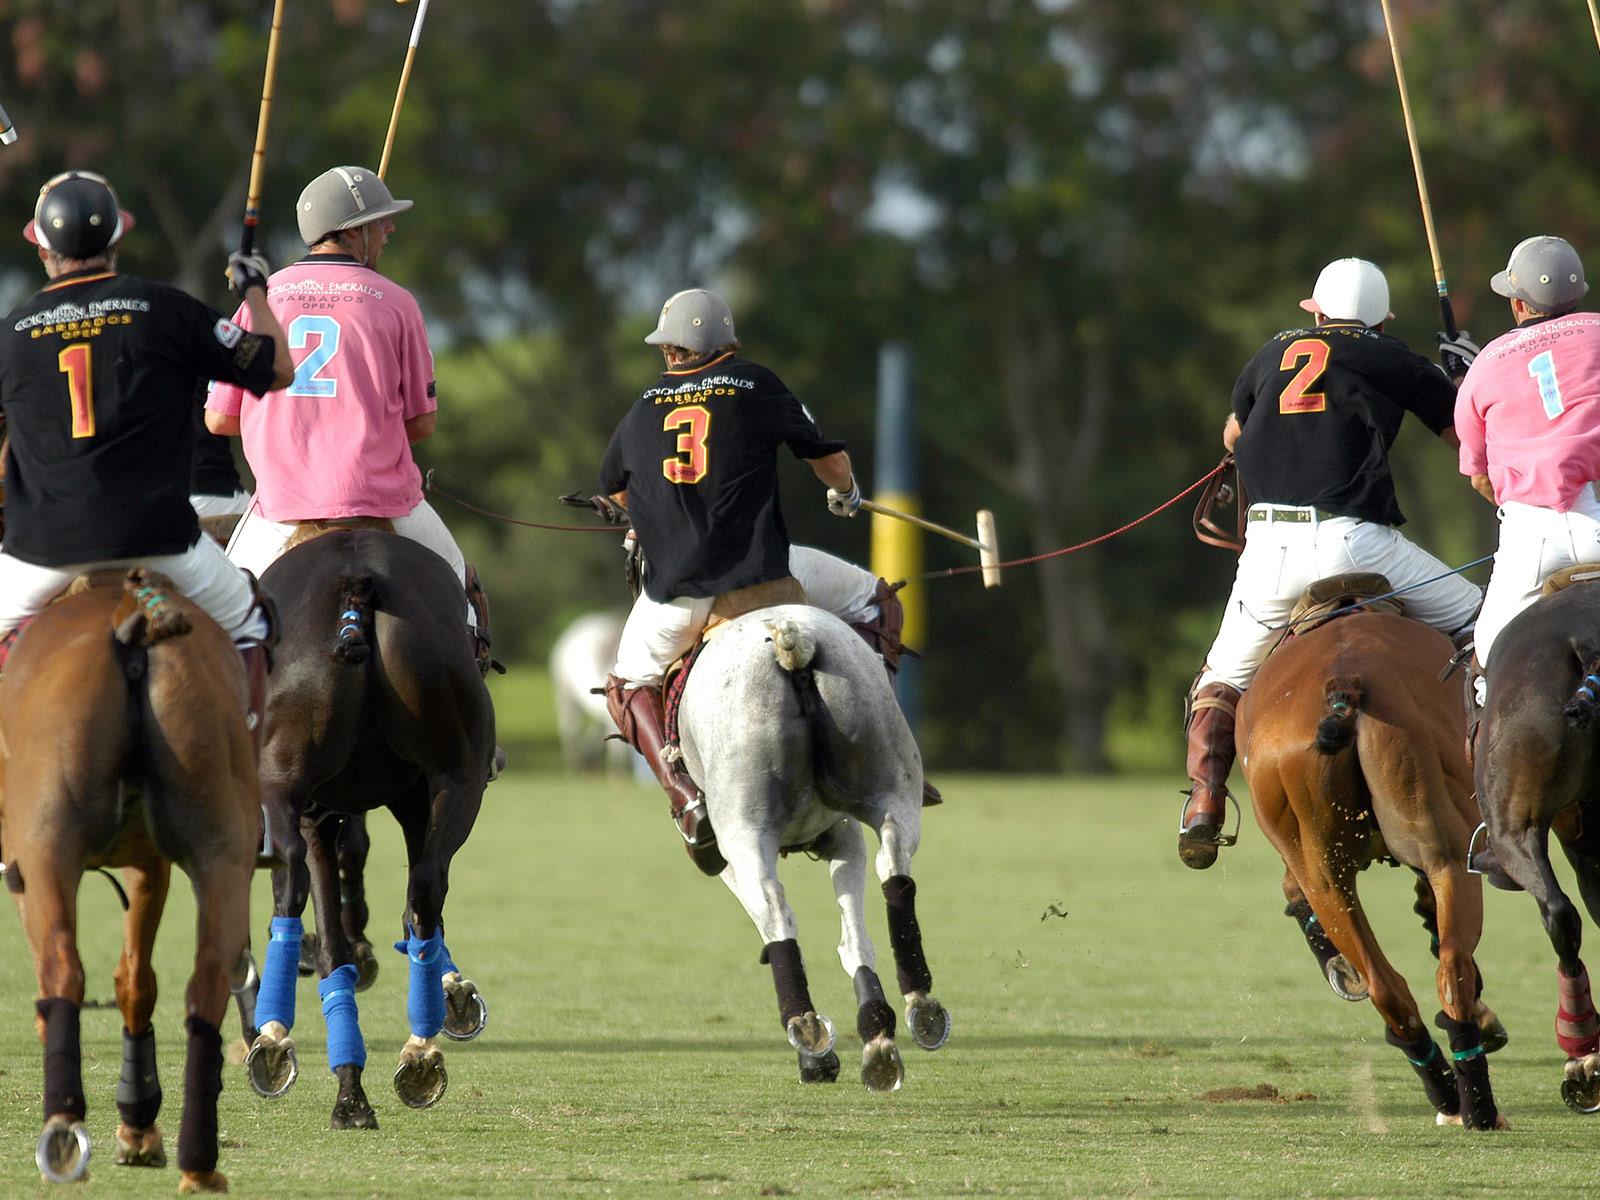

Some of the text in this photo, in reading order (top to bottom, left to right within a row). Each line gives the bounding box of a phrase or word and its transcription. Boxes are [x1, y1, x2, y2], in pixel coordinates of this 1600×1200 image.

[277, 295, 364, 304] BARBADOS
[328, 282, 384, 300] EMERALDS
[88, 299, 150, 314] EMERALDS
[31, 315, 132, 339] BARBADOS
[61, 327, 101, 340] OPEN
[1499, 329, 1585, 359] BARBADOS
[1525, 340, 1557, 353] OPEN
[286, 314, 341, 398] 2
[701, 375, 755, 390] EMERALDS
[1280, 338, 1330, 414] 2
[1527, 350, 1565, 420] 1
[58, 343, 96, 439] 1
[655, 388, 736, 405] BARBADOS
[663, 405, 710, 484] 3
